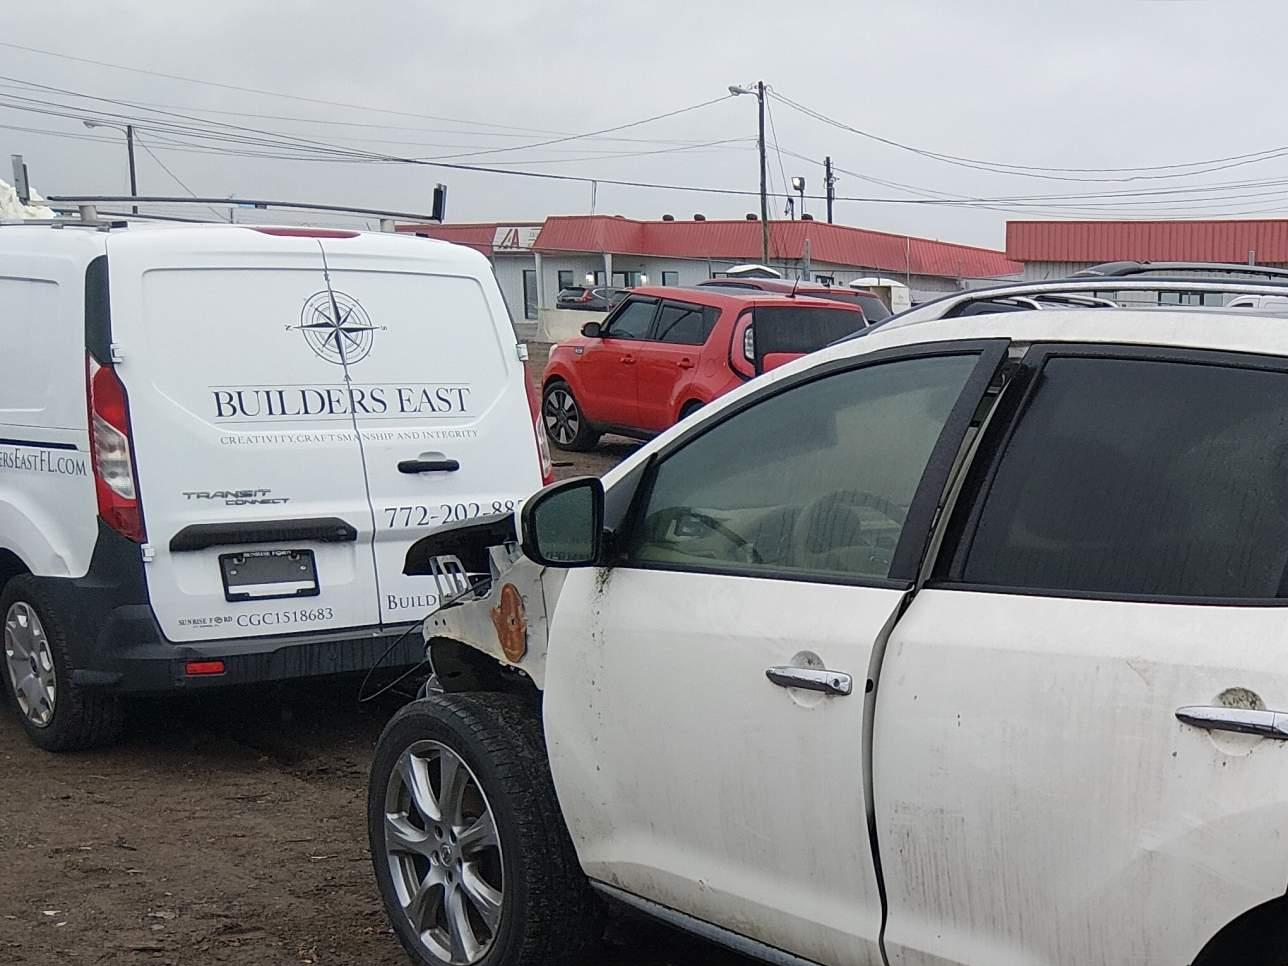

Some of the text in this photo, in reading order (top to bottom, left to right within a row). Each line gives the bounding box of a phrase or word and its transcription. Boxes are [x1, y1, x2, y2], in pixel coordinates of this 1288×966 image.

[213, 386, 472, 418] BUILDERS EAST
[396, 430, 420, 441] AND
[422, 428, 479, 440] INTEGRITY
[182, 488, 272, 500] TRANSIT
[225, 498, 290, 506] CONNECT
[384, 499, 524, 529] 772-202-88
[387, 594, 443, 610] BUILD
[236, 607, 334, 627] CGC1518683
